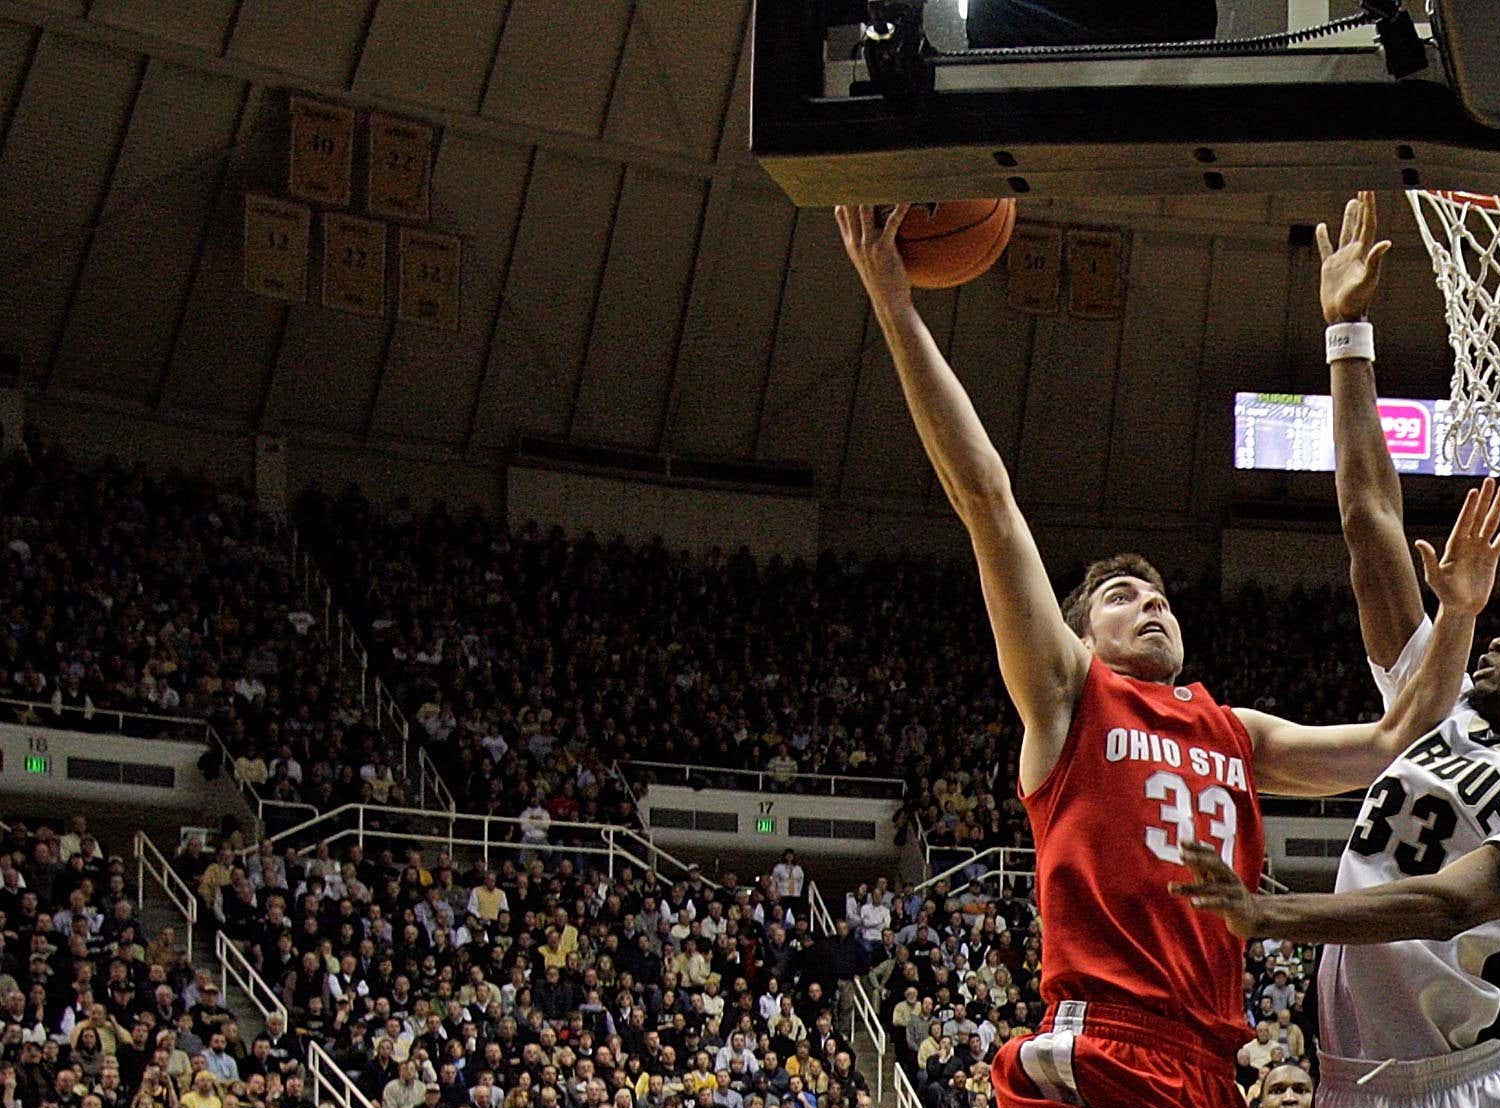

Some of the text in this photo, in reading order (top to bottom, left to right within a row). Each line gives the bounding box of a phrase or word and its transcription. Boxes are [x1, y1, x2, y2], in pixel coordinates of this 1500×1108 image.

[1106, 727, 1182, 768] OHIO
[758, 801, 774, 815] 17
[1145, 769, 1238, 869] 33
[1348, 775, 1458, 876] 33
